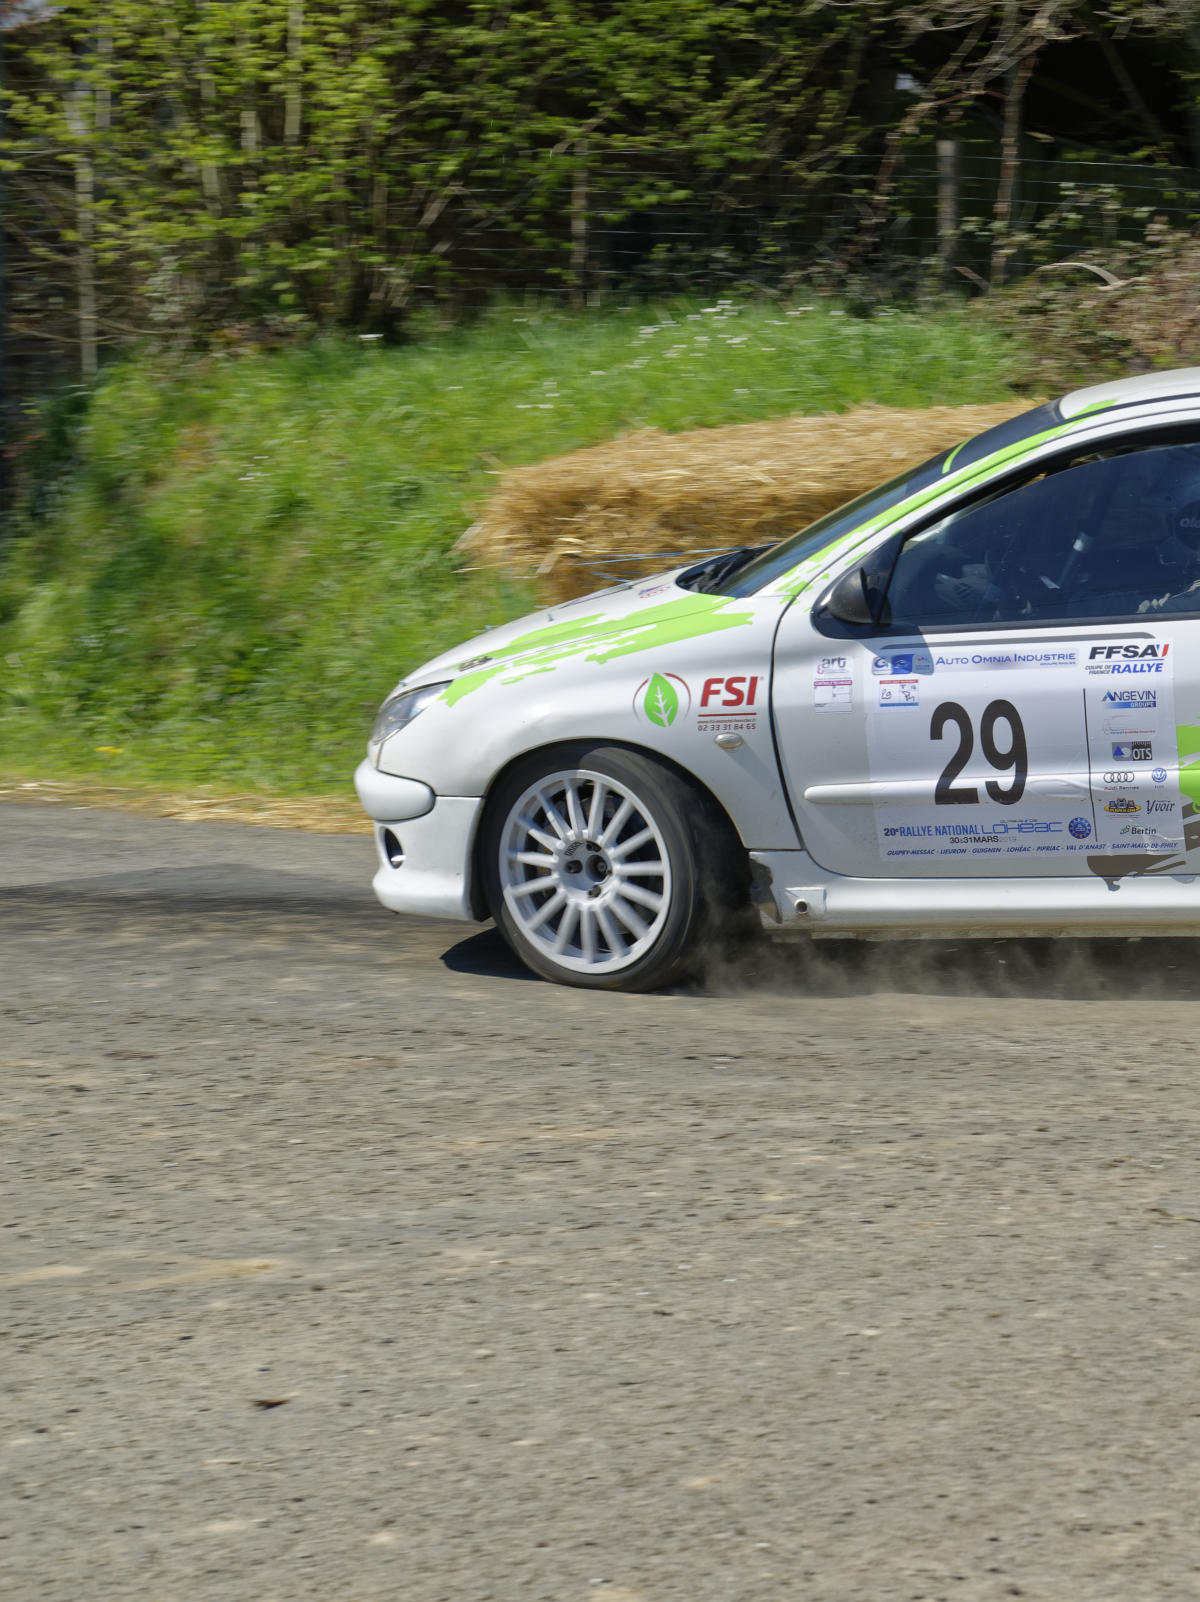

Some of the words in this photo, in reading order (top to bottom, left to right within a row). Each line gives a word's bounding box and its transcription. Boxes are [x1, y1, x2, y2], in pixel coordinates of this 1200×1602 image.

[1089, 644, 1159, 660] FFSA
[1111, 662, 1164, 674] RALLYE
[700, 676, 758, 707] FSI
[1102, 690, 1156, 702] ANGEVIN
[930, 699, 1028, 805] 29
[1132, 748, 1152, 760] OTS
[899, 826, 932, 837] RALLYE
[935, 824, 981, 836] NATIONAL
[1131, 826, 1157, 835] Bertin
[973, 835, 999, 843] MARS
